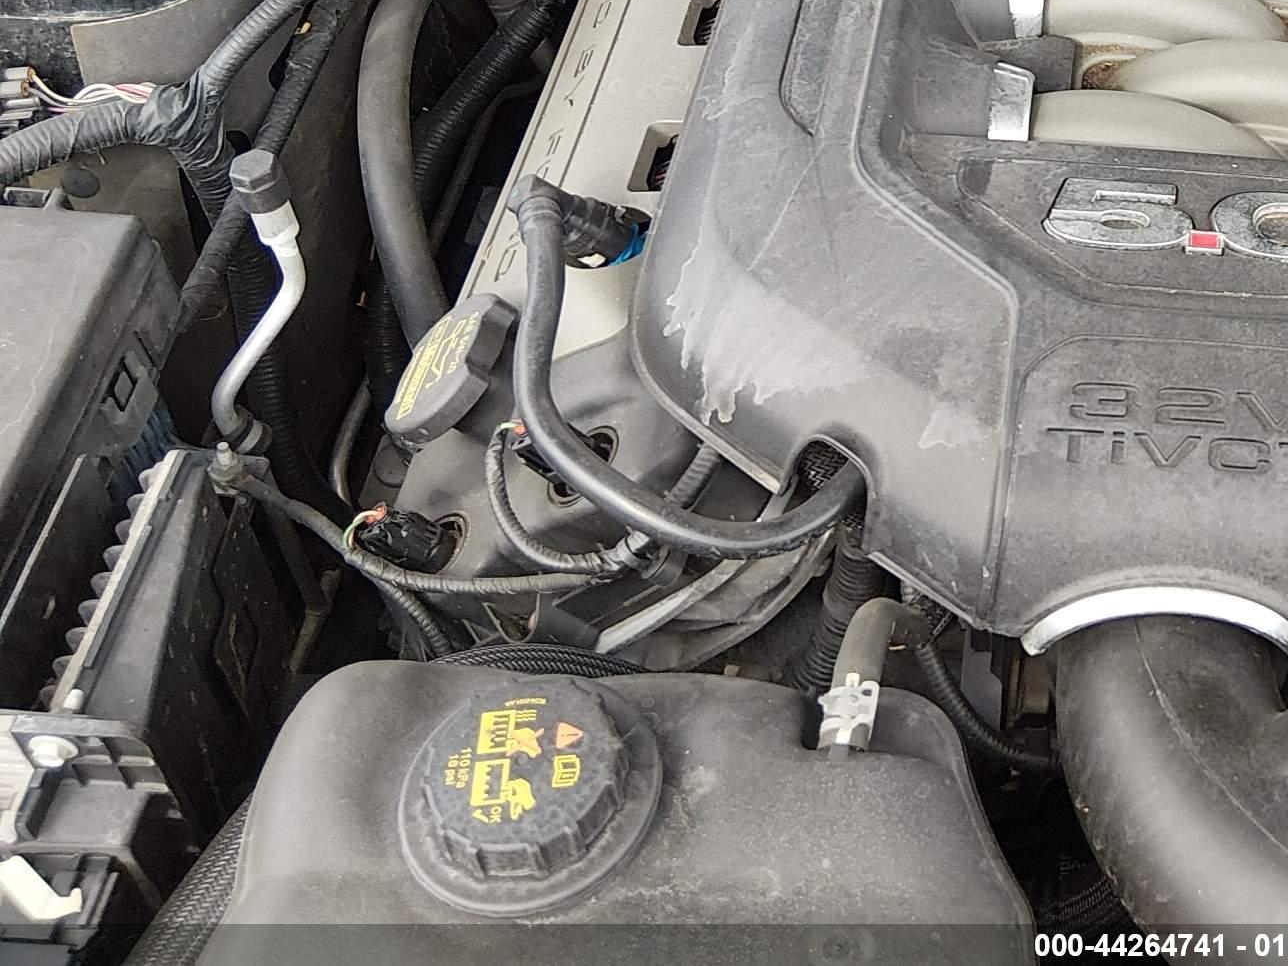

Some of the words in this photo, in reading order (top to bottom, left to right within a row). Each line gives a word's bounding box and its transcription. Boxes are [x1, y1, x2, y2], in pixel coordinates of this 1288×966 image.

[459, 747, 473, 768] 110
[443, 769, 456, 786] psi
[455, 767, 470, 790] kPa
[489, 806, 503, 824] OK
